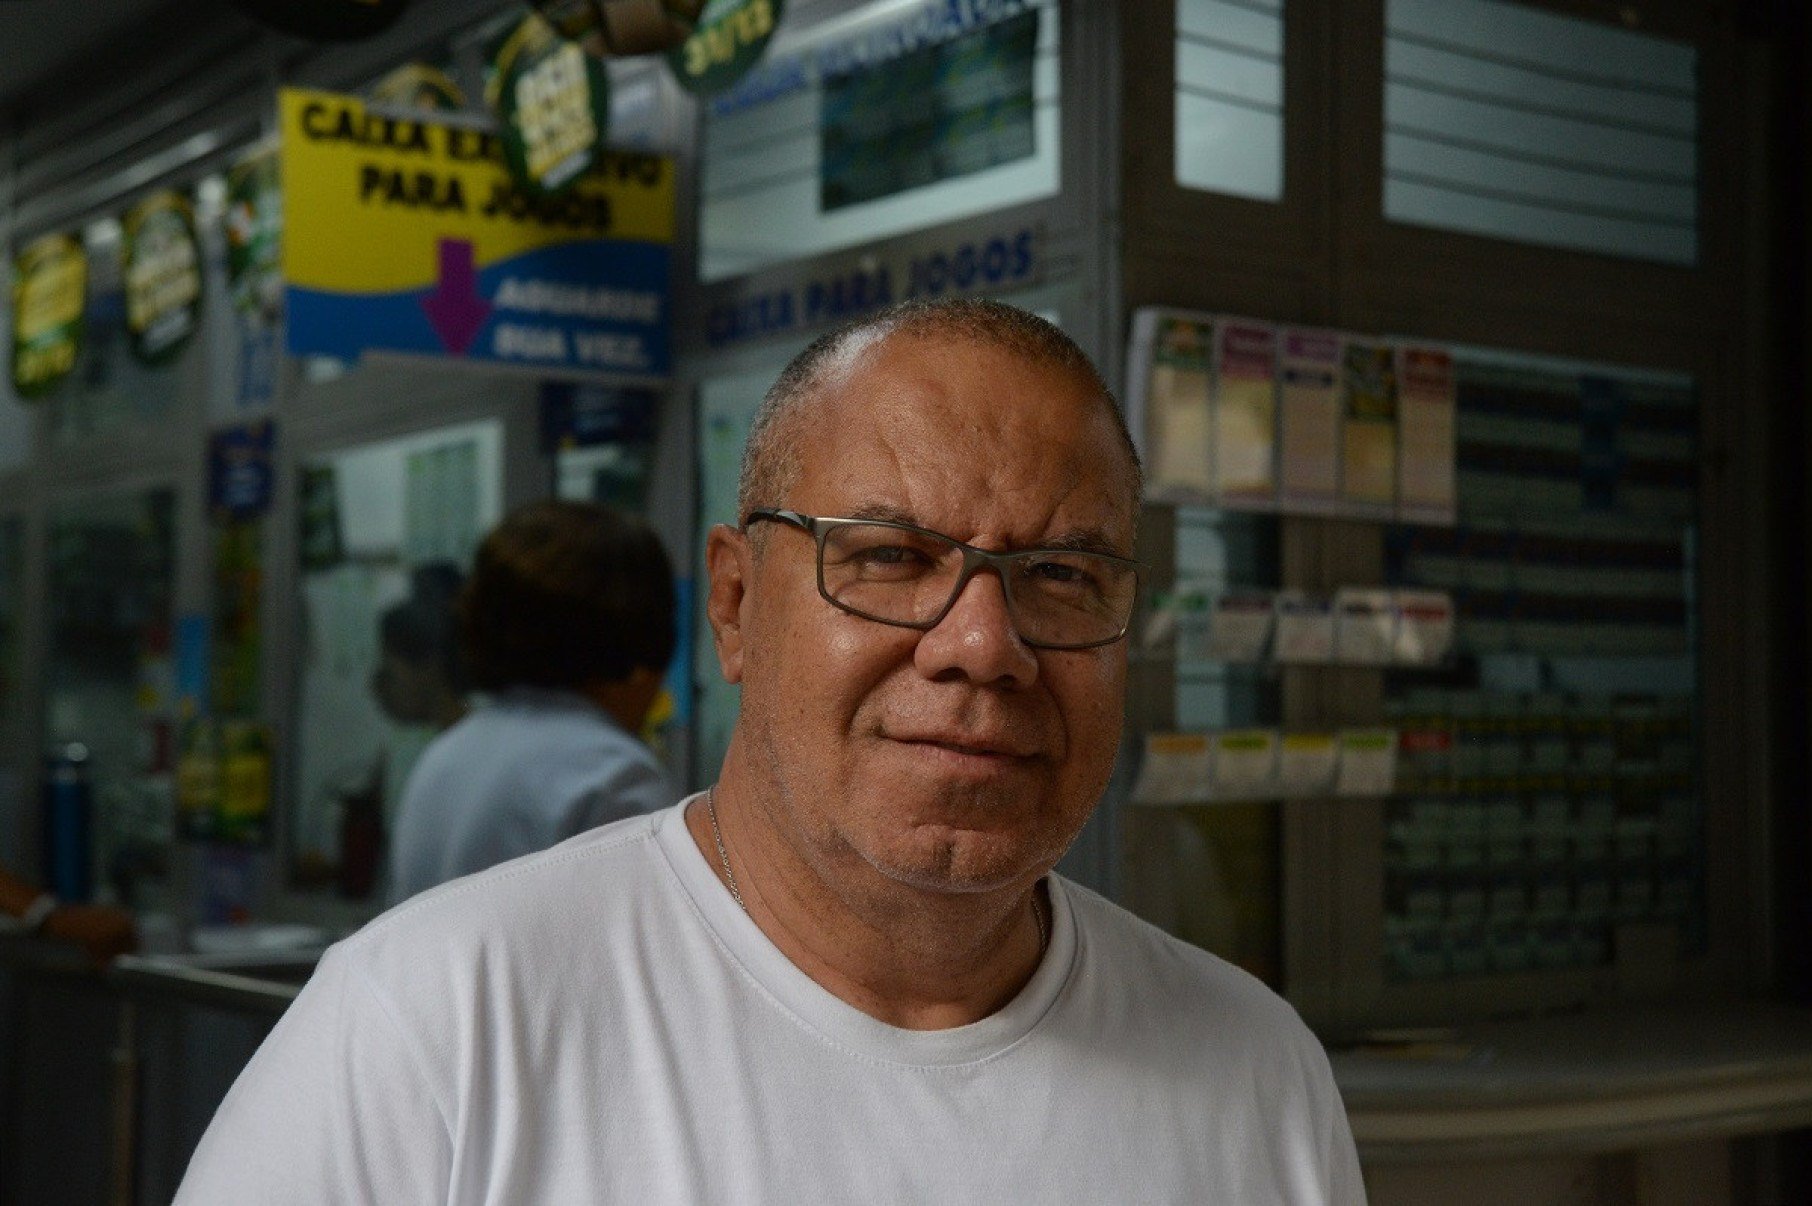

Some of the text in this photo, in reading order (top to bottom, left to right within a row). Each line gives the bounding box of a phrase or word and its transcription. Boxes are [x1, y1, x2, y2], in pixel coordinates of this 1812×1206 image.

[303, 103, 430, 153] CAIXA
[360, 165, 466, 212] PARA
[805, 264, 891, 318] PARA
[908, 228, 1033, 299] JOGOS
[494, 276, 662, 325] AGUARDE
[493, 321, 567, 361] SUA
